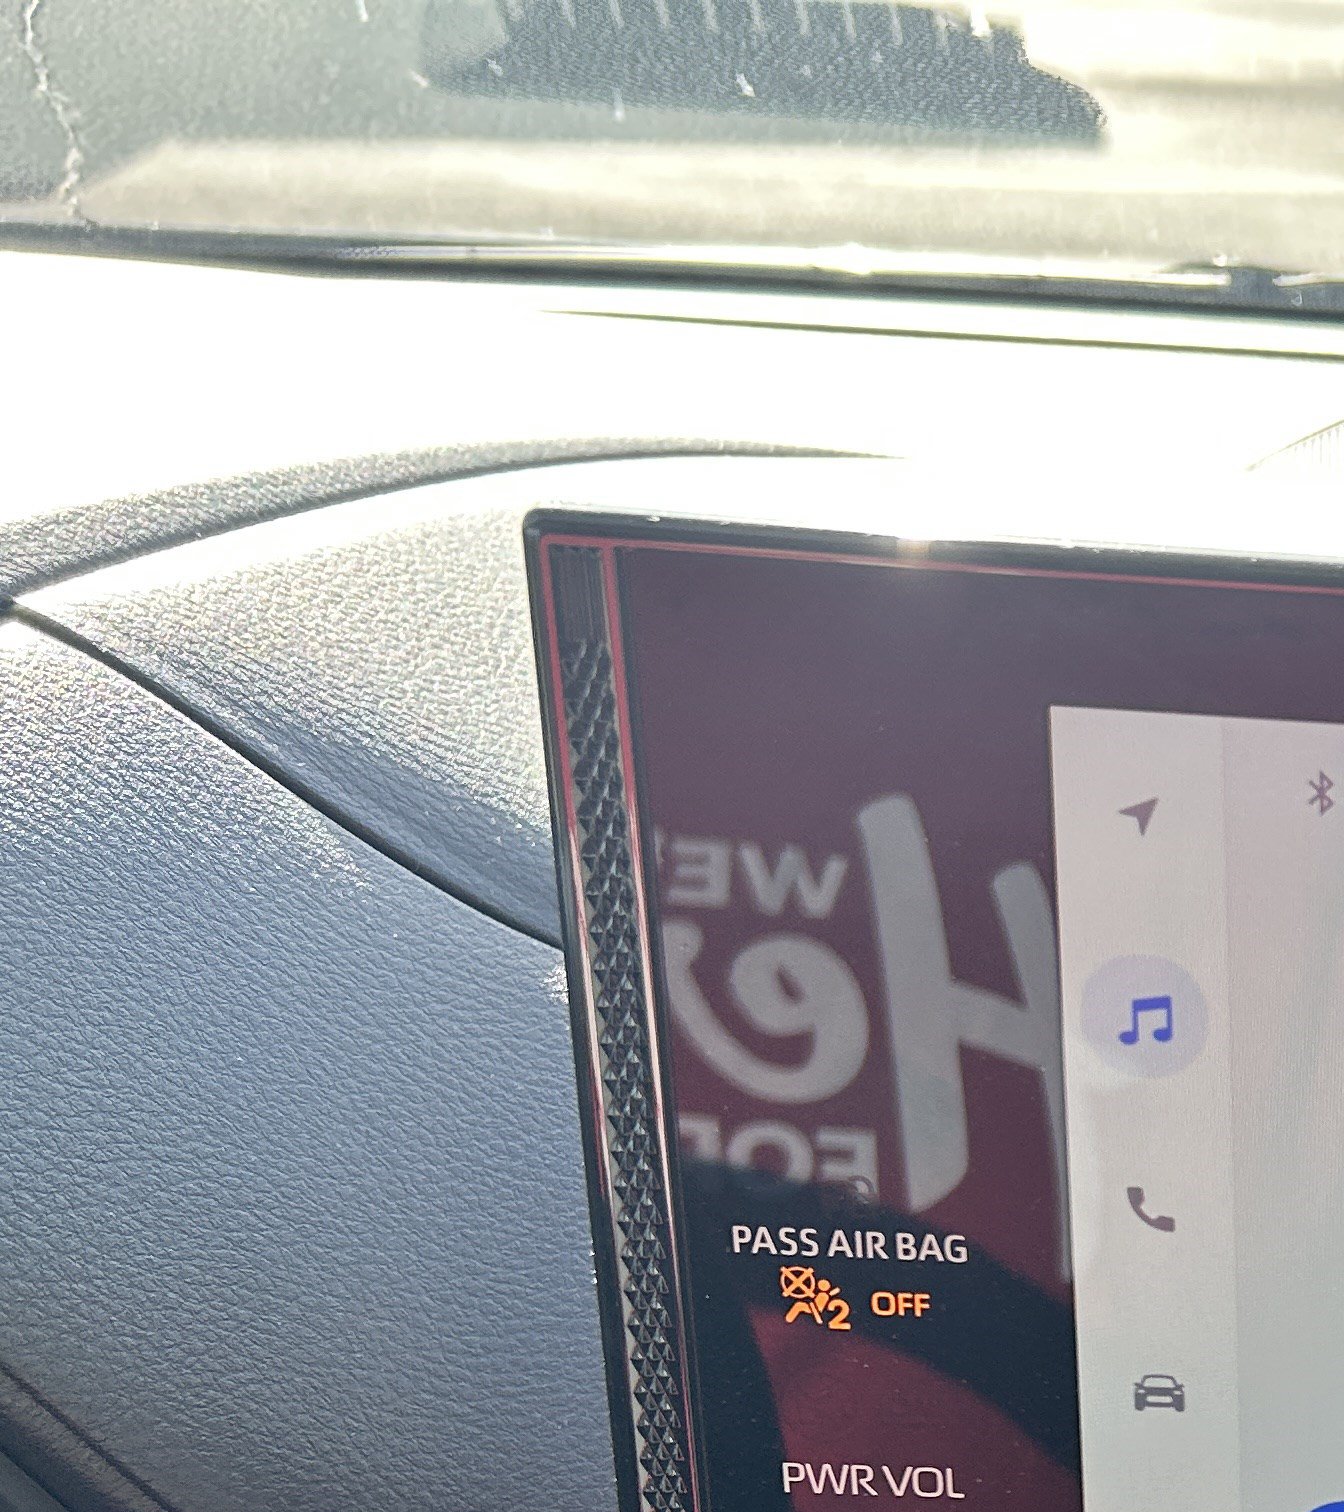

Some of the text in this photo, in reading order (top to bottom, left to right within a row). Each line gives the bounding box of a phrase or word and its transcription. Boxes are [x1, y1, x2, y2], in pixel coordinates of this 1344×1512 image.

[731, 1225, 969, 1263] PASS AIR BAG
[870, 1291, 931, 1317] OFF
[781, 1461, 966, 1499] PWR VOL
